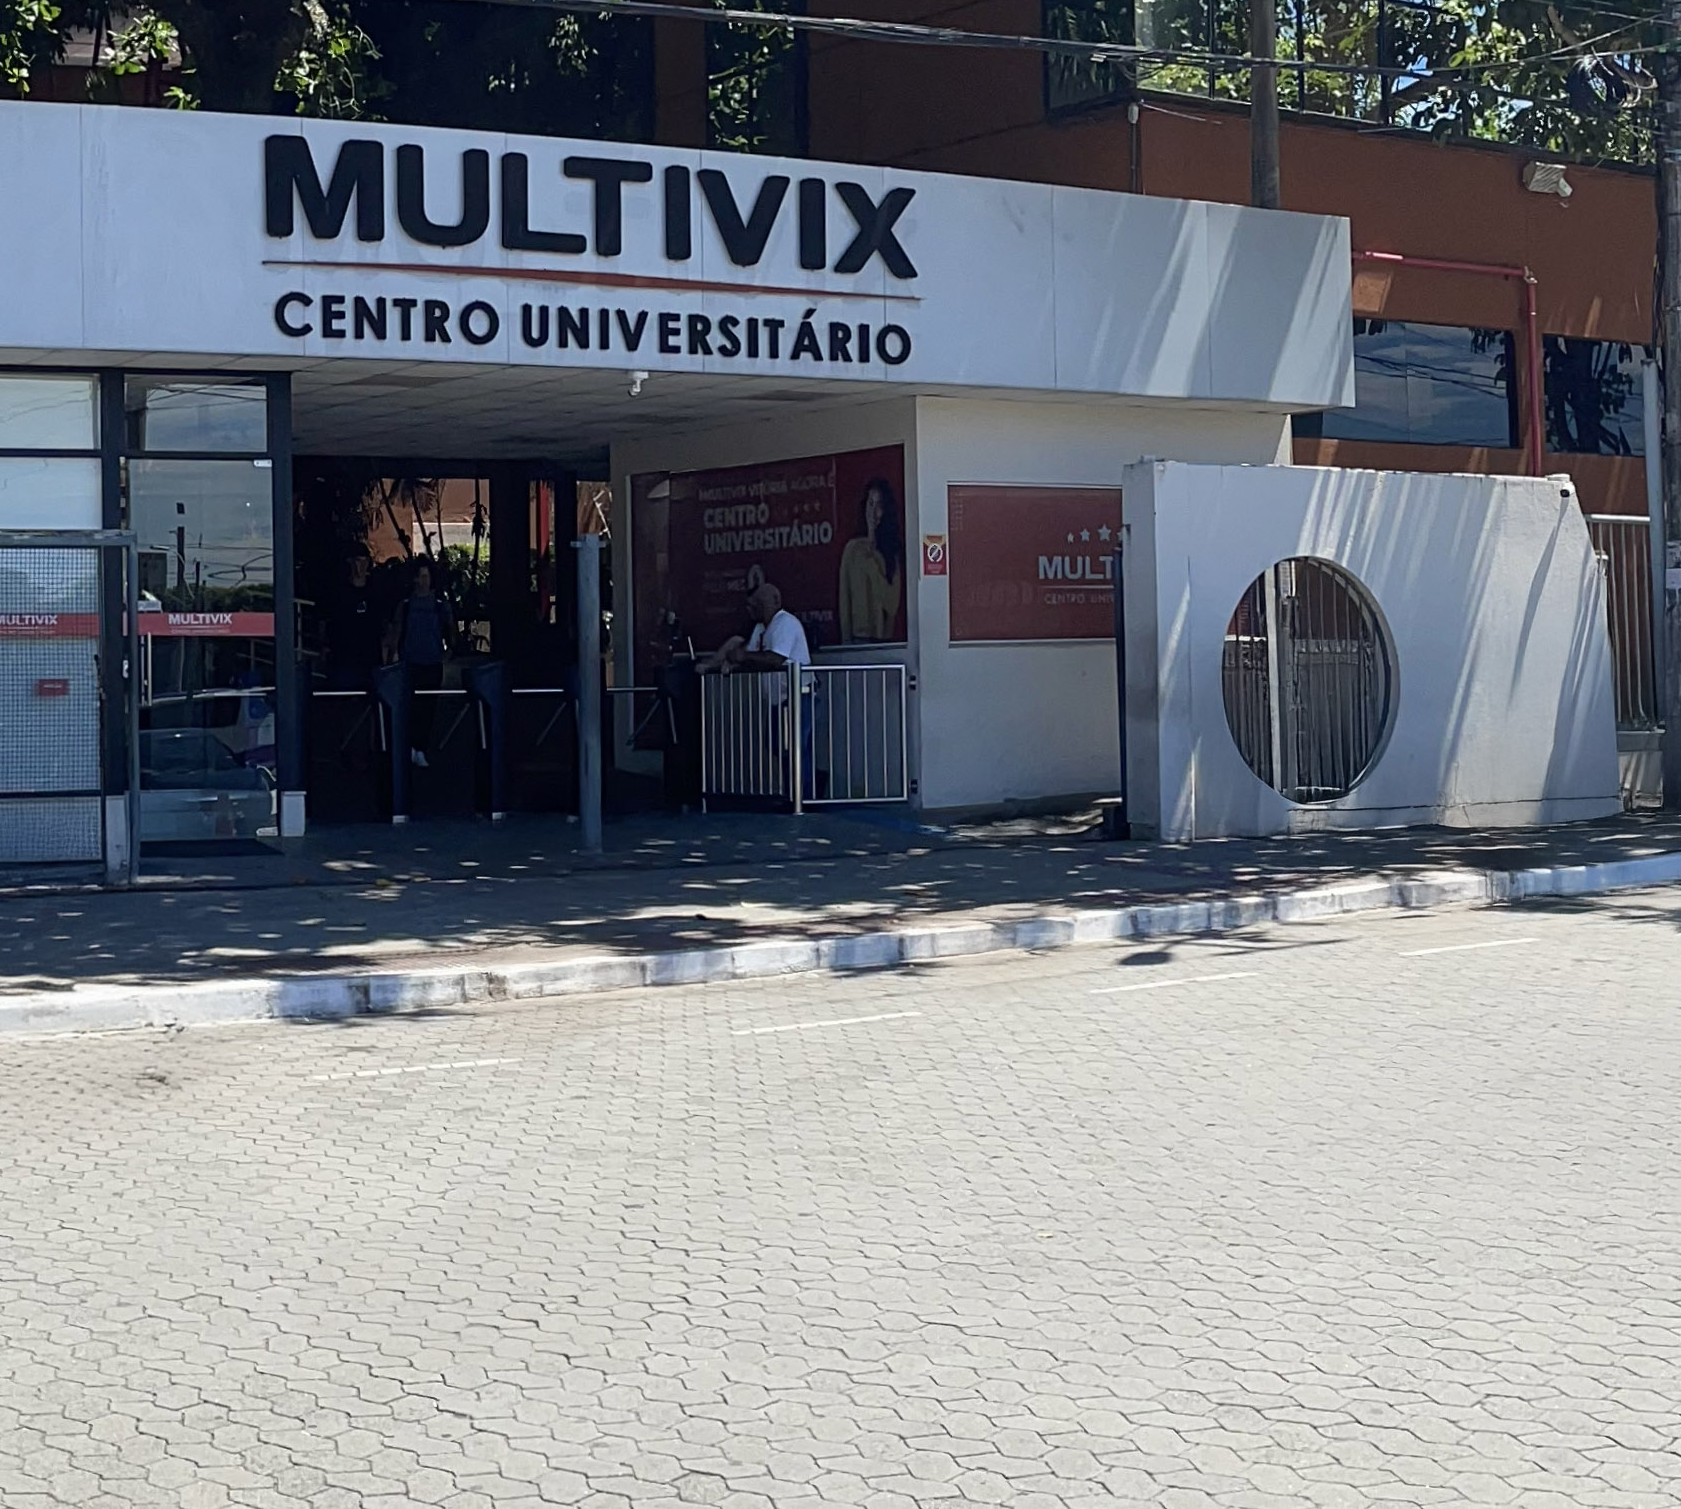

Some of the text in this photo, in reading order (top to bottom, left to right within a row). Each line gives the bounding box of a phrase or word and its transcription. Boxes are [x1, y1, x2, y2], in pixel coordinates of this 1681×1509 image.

[263, 134, 919, 279] MULTIVIX
[274, 292, 912, 365] CENTRO UNIVERSITÁRIO
[703, 502, 770, 529] CENTRO
[703, 519, 833, 555] UNIVERSITÁRIO
[1038, 555, 1114, 580] MULT
[168, 613, 233, 625] MULTIVIX
